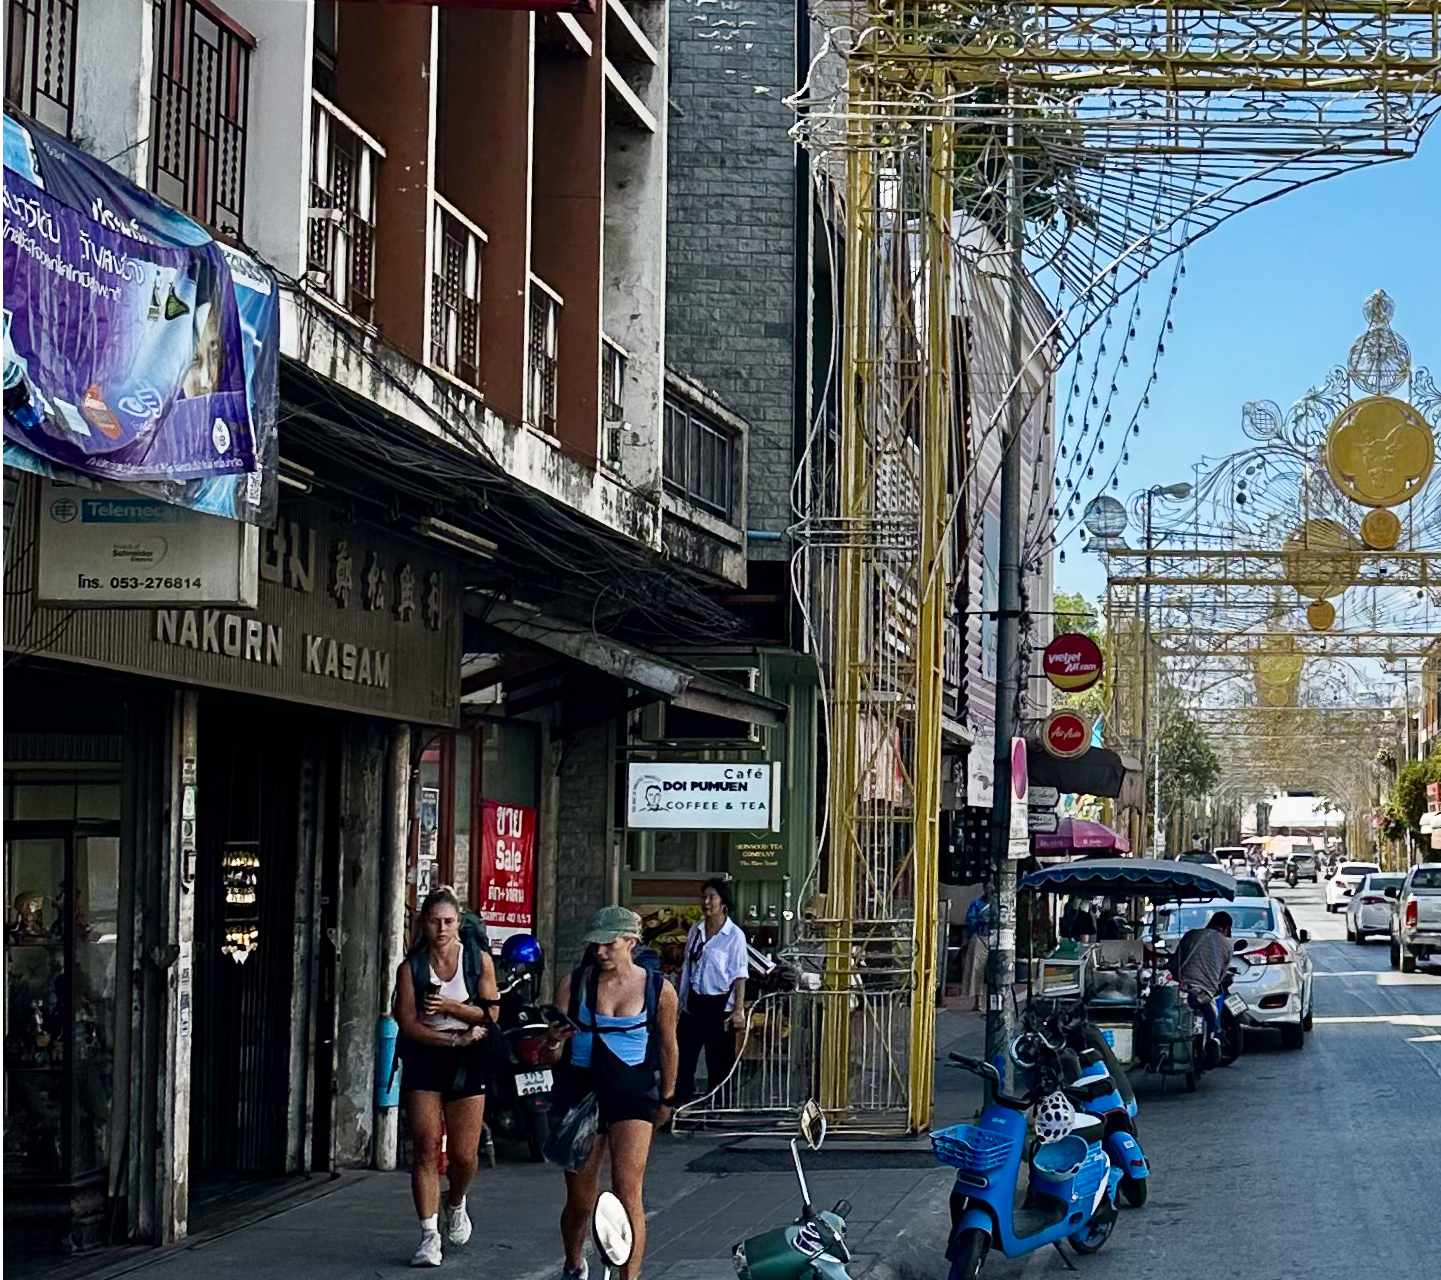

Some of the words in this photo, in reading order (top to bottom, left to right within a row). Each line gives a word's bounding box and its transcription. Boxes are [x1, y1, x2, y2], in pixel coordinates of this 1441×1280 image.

[110, 577, 202, 589] 053-276814
[156, 608, 282, 666] NAKORN
[306, 634, 390, 688] KASAM
[724, 768, 763, 780] Café
[662, 781, 687, 792] DOI
[690, 781, 748, 792] PUMUEN
[666, 801, 718, 810] COFFEE
[725, 801, 733, 810] &
[741, 801, 766, 810] TEA
[496, 806, 524, 838] ขาย
[495, 839, 522, 873] Sale
